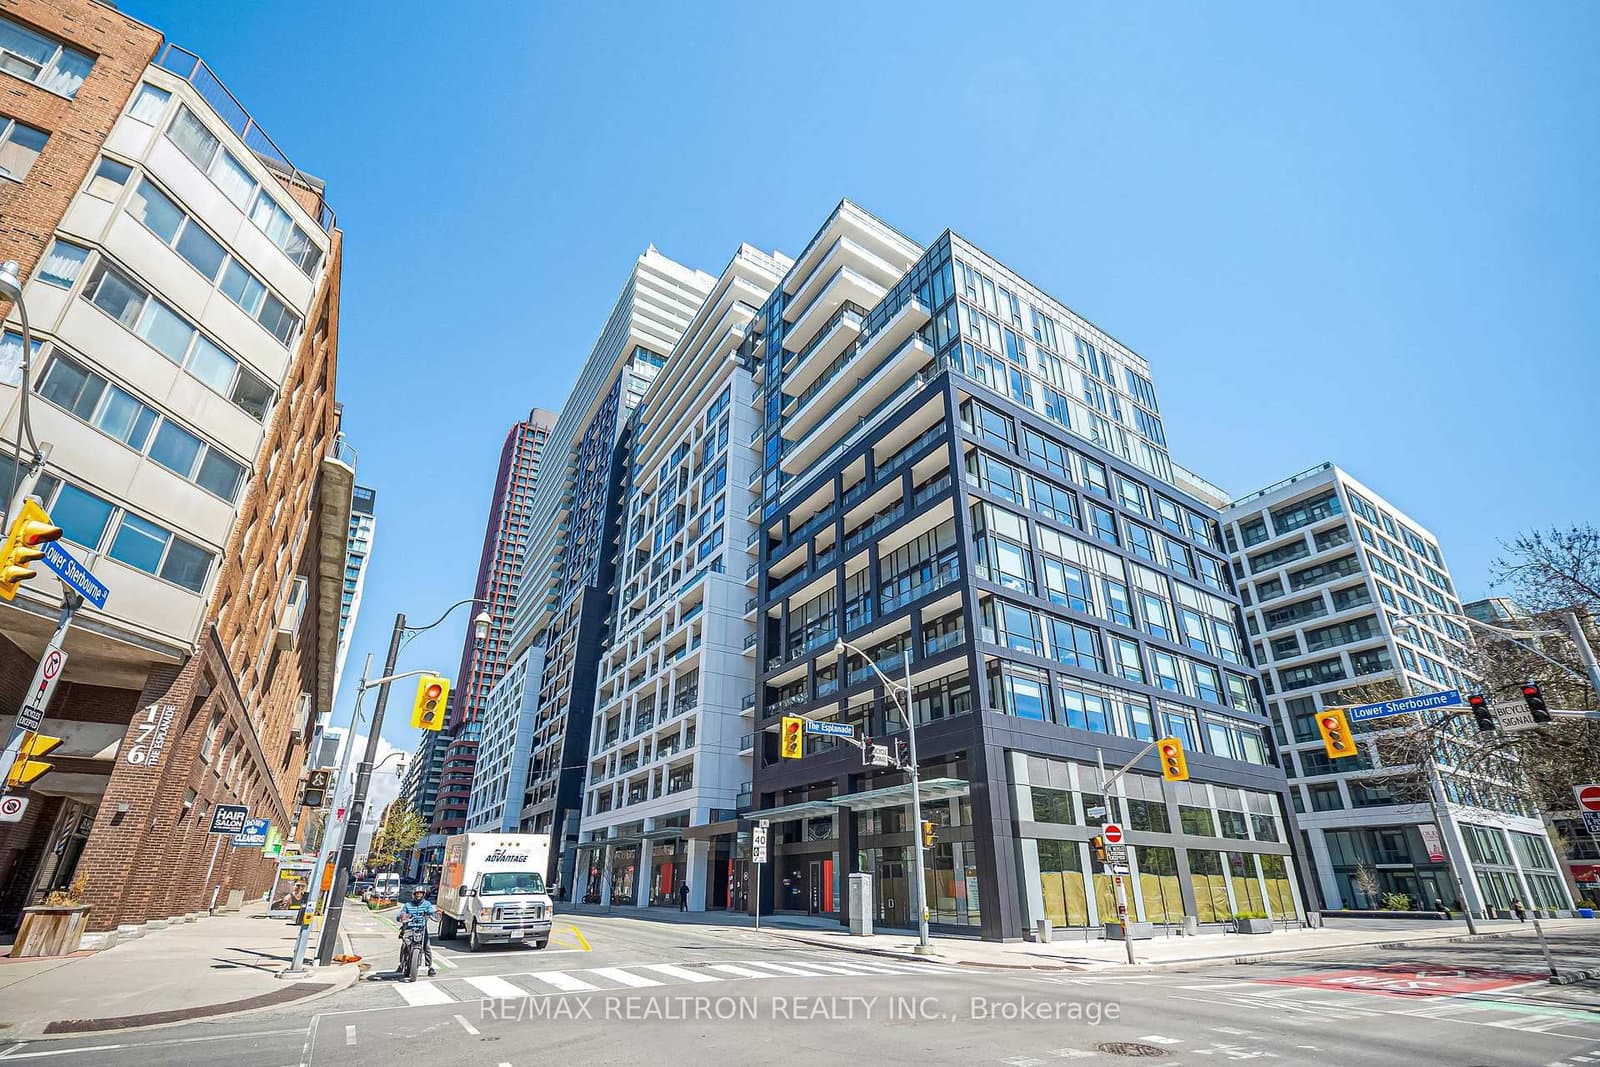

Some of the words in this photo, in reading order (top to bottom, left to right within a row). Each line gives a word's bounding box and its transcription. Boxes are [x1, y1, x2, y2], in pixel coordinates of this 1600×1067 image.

[64, 559, 102, 601] Sherbourne
[1353, 705, 1384, 718] Lower
[1386, 694, 1448, 713] Sherbourne
[1496, 703, 1532, 717] BICYCLE
[153, 704, 177, 750] ESPLANADE
[1502, 714, 1535, 728] SIGNAL
[807, 721, 820, 731] The
[821, 723, 853, 736] Esplanade
[147, 749, 162, 768] THE
[214, 819, 243, 827] SALON
[216, 811, 246, 821] HAIR
[754, 835, 767, 845] 40
[484, 855, 528, 863] ADVANTAGE
